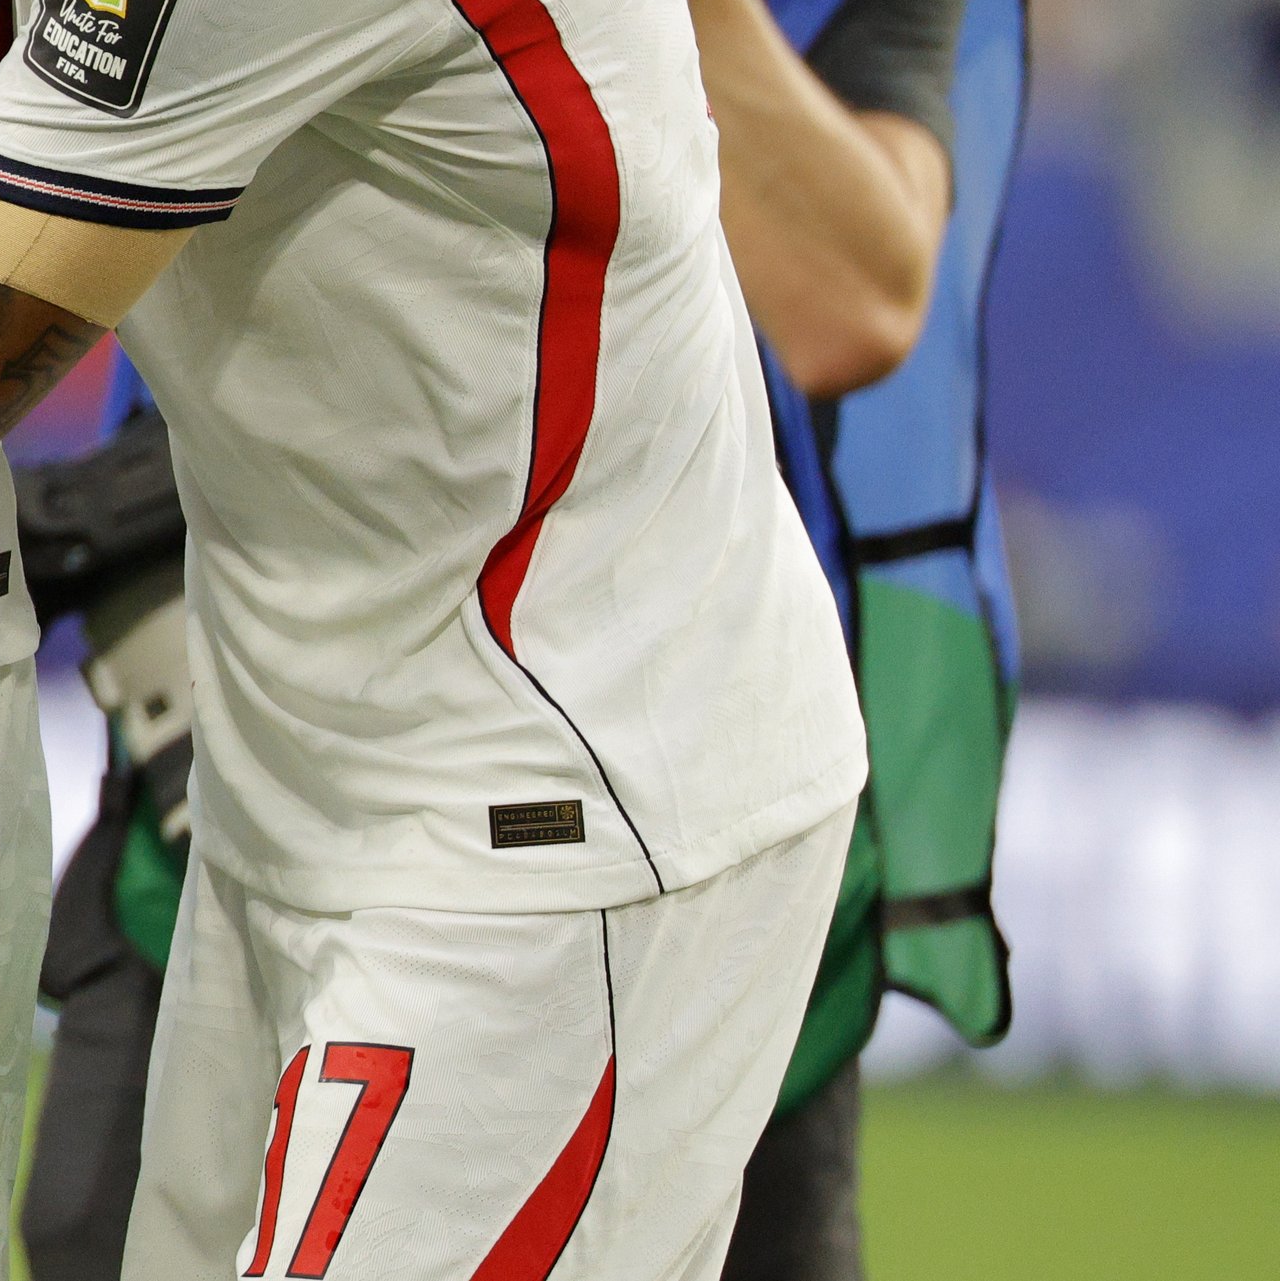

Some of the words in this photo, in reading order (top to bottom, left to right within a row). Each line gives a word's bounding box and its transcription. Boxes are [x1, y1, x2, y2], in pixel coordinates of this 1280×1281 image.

[42, 16, 128, 81] EDUCATION
[98, 20, 123, 45] For
[55, 56, 88, 84] FIFA
[241, 1040, 416, 1281] 17
